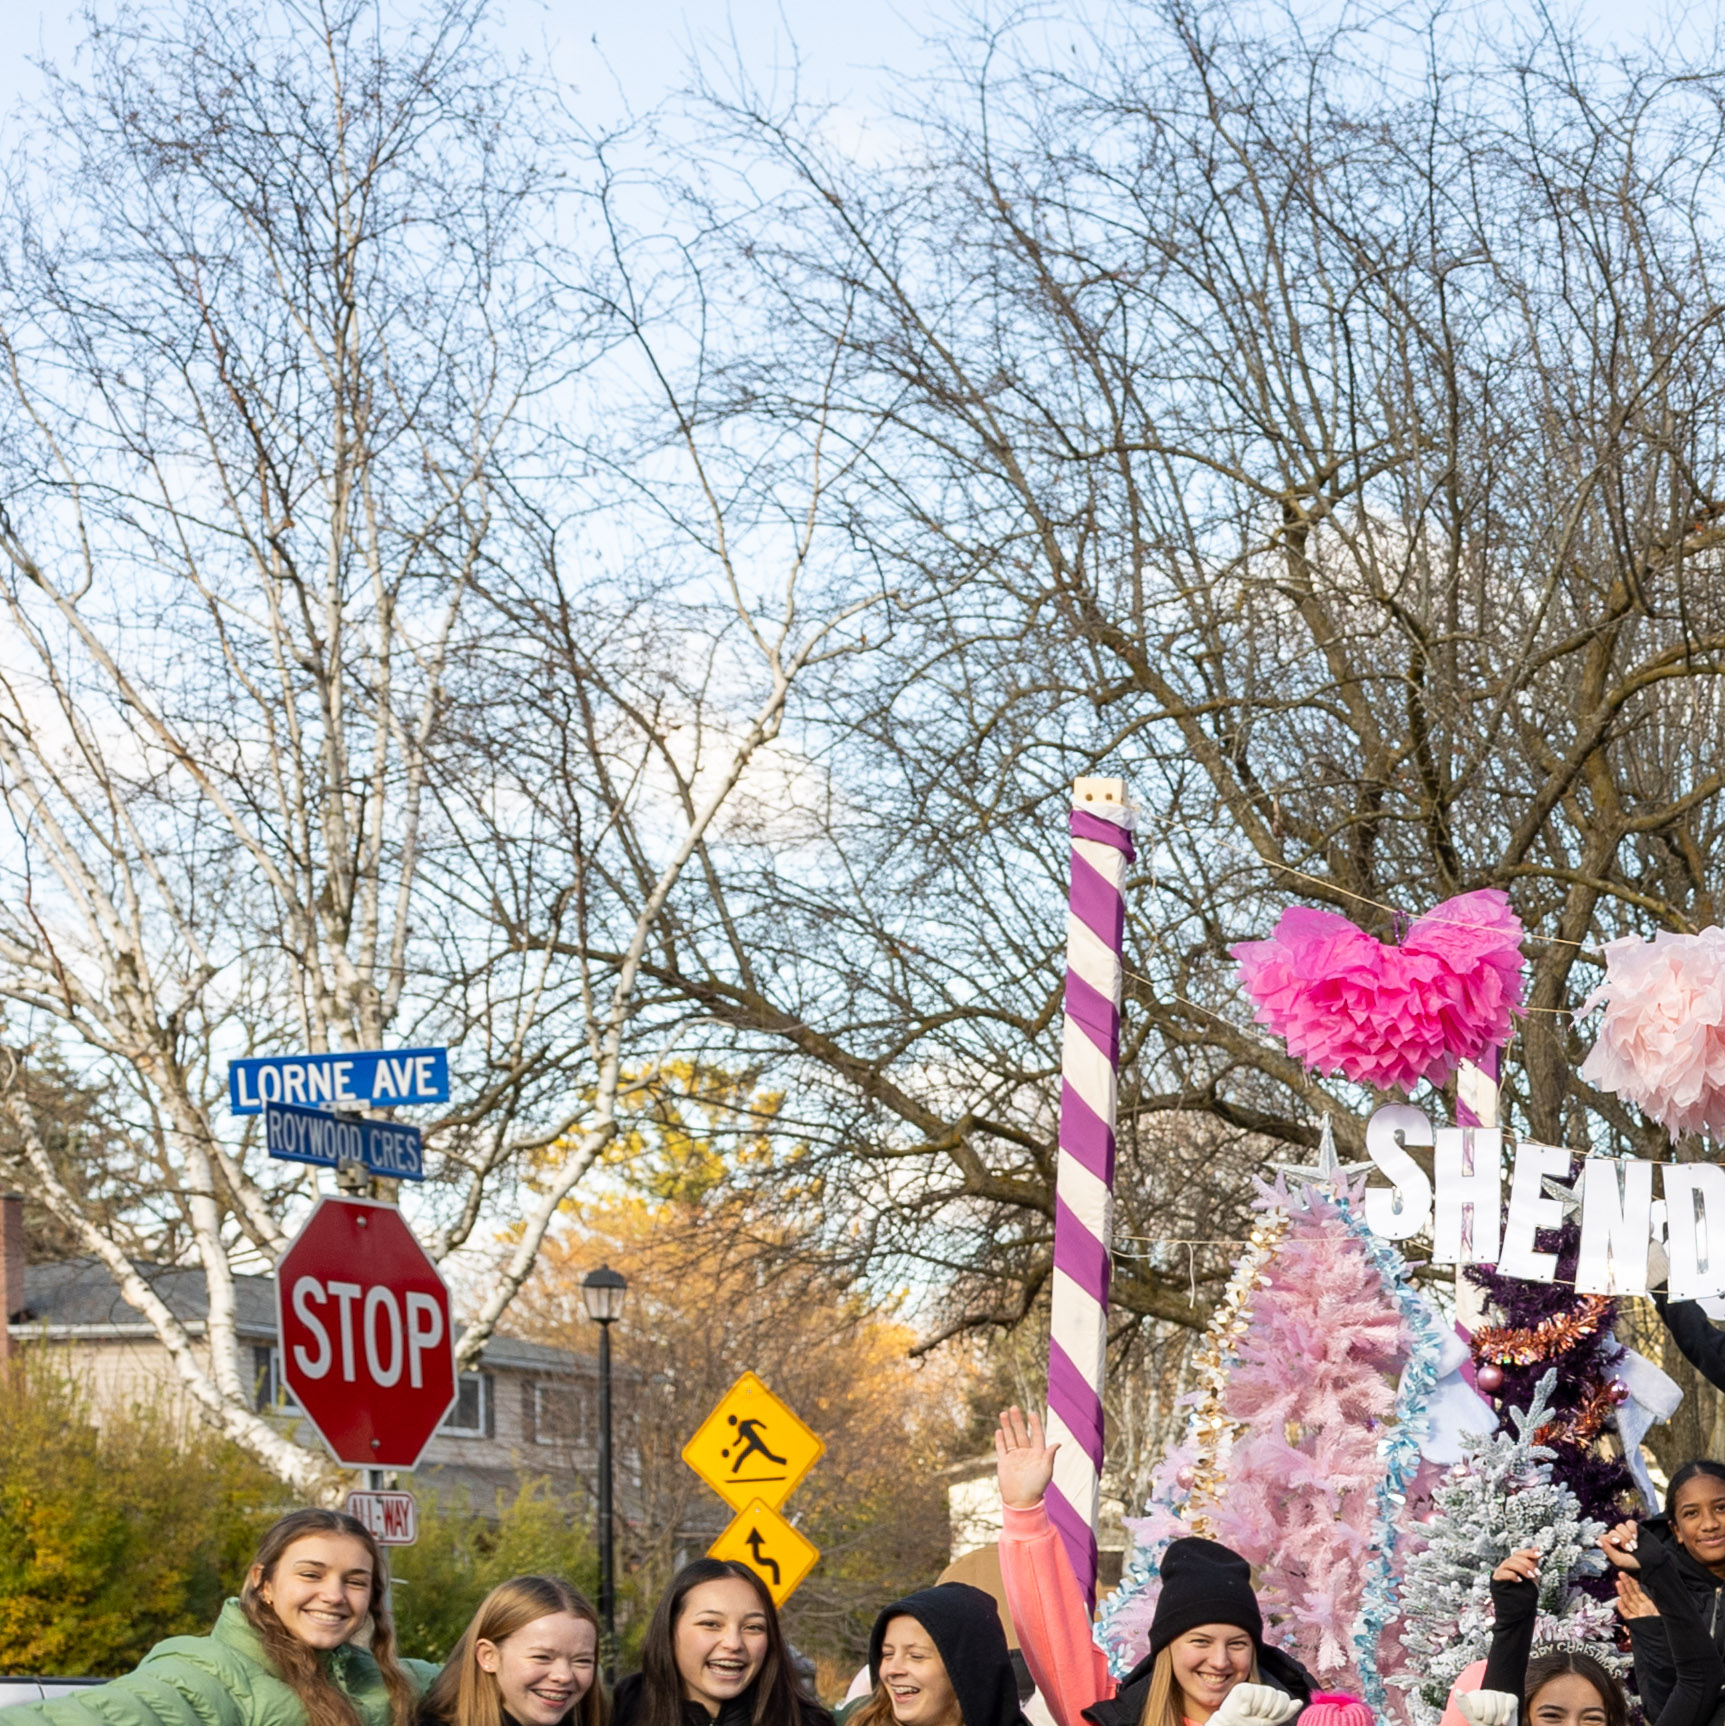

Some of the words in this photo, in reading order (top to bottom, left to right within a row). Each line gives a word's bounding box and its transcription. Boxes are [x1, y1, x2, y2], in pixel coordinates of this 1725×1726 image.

[237, 1061, 356, 1107] LORNE
[372, 1056, 439, 1099] AVE
[268, 1109, 363, 1162] ROYWOOD
[370, 1128, 420, 1173] CRES
[292, 1275, 444, 1389] STOP
